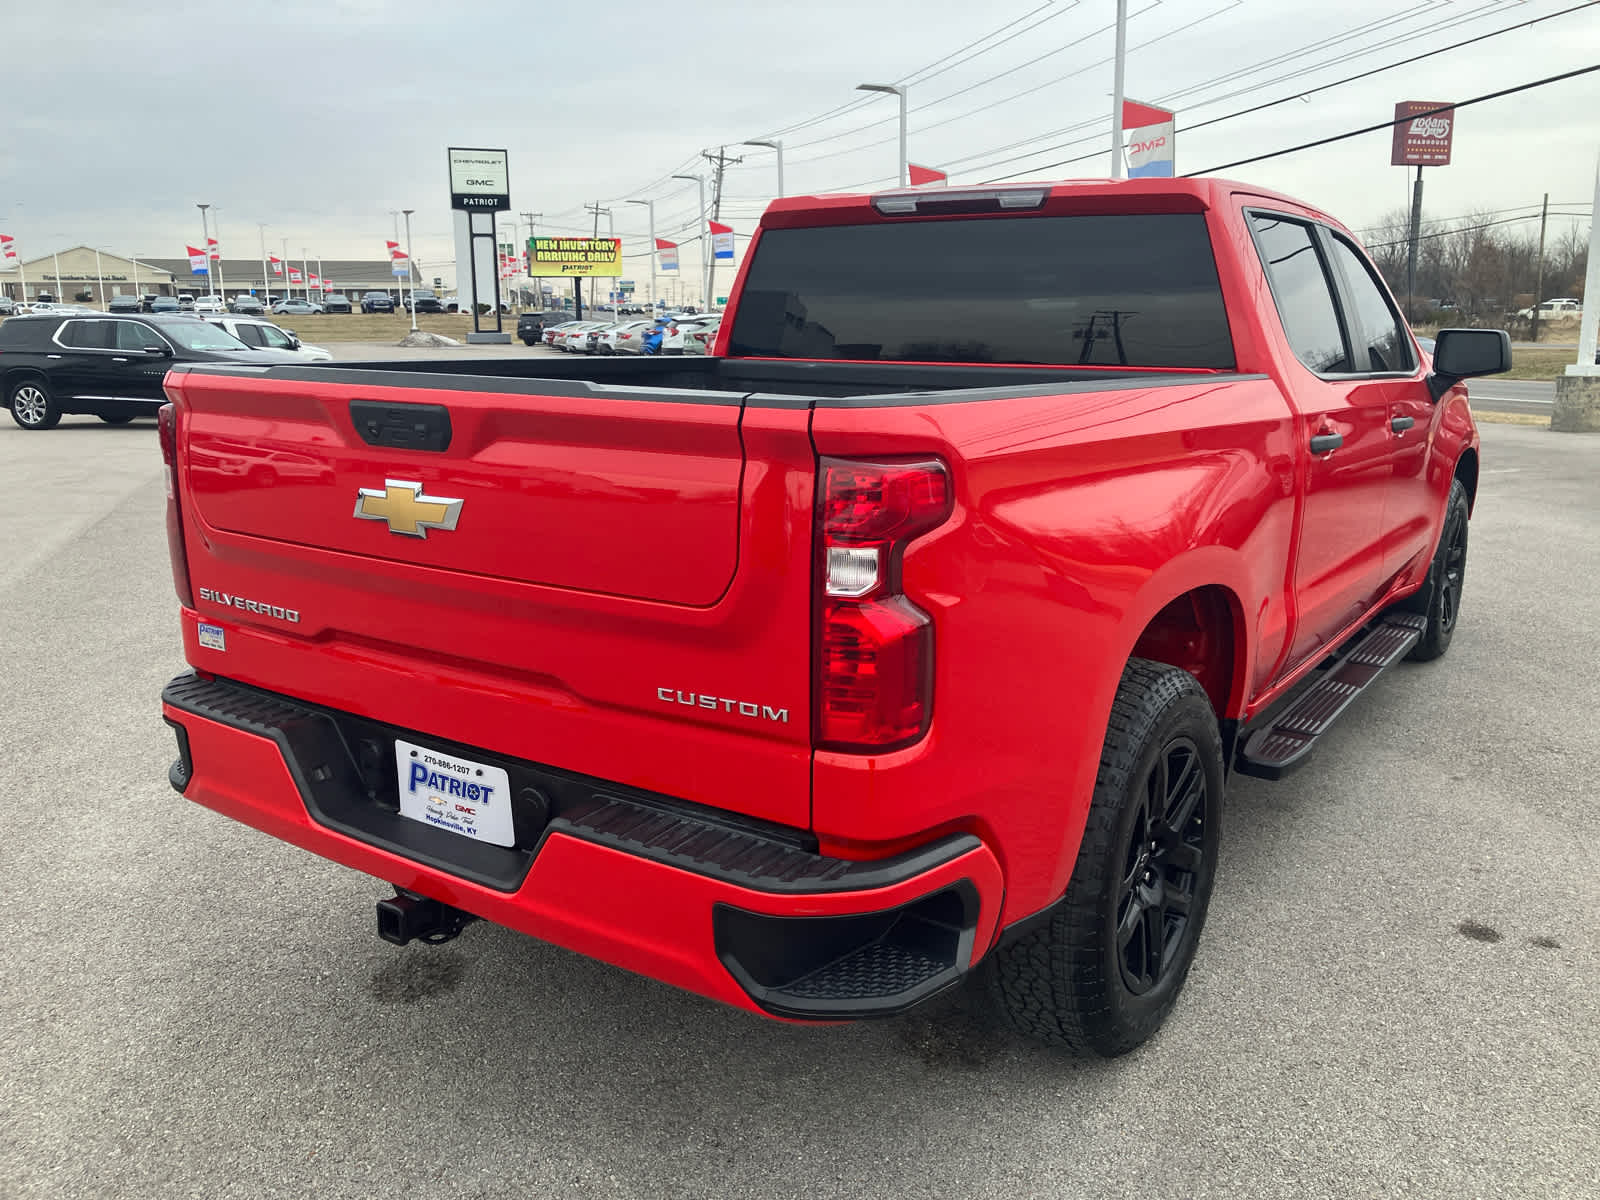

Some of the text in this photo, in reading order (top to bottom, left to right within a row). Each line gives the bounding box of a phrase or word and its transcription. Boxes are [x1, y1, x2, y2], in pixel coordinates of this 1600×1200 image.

[463, 197, 498, 206] PATRIOT
[536, 239, 616, 251] NEW INVENTORY
[537, 251, 615, 261] ARRIVING DAILY
[562, 264, 593, 272] PATRIOT
[199, 587, 300, 623] SILVERADO
[657, 687, 789, 723] CUSTOM
[424, 755, 470, 776] 270-886-1207
[409, 761, 493, 803] PATRIOT
[455, 804, 476, 815] GMC
[425, 813, 466, 832] Hopkinsville,
[467, 826, 477, 835] KY
